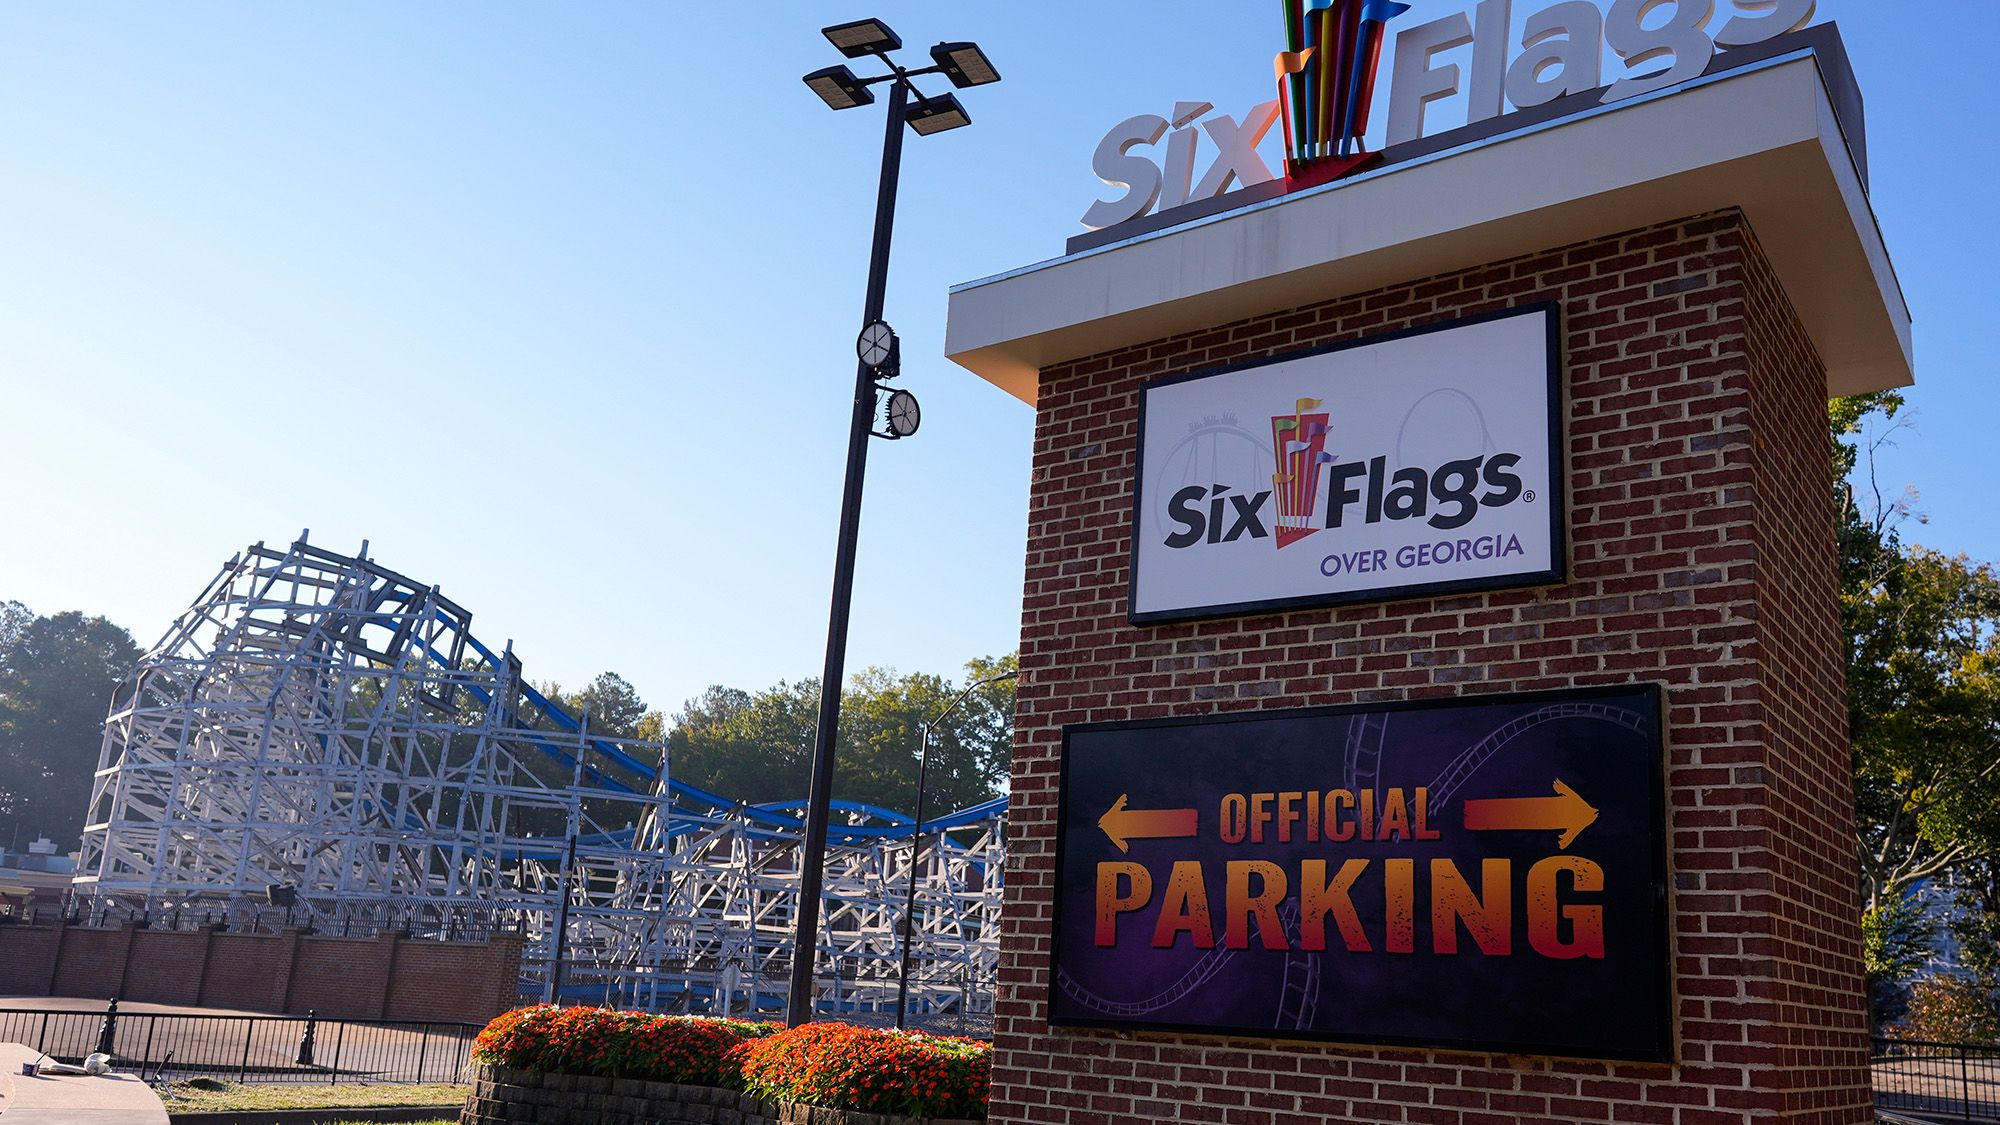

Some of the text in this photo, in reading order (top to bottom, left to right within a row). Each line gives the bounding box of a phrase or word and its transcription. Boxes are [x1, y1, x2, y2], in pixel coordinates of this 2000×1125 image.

[1080, 101, 1281, 228] Six
[1163, 484, 1271, 549] Six
[1320, 533, 1525, 577] OVER GEORGIA
[1219, 786, 1441, 844] OFFICIAL
[1094, 855, 1605, 959] PARKING
